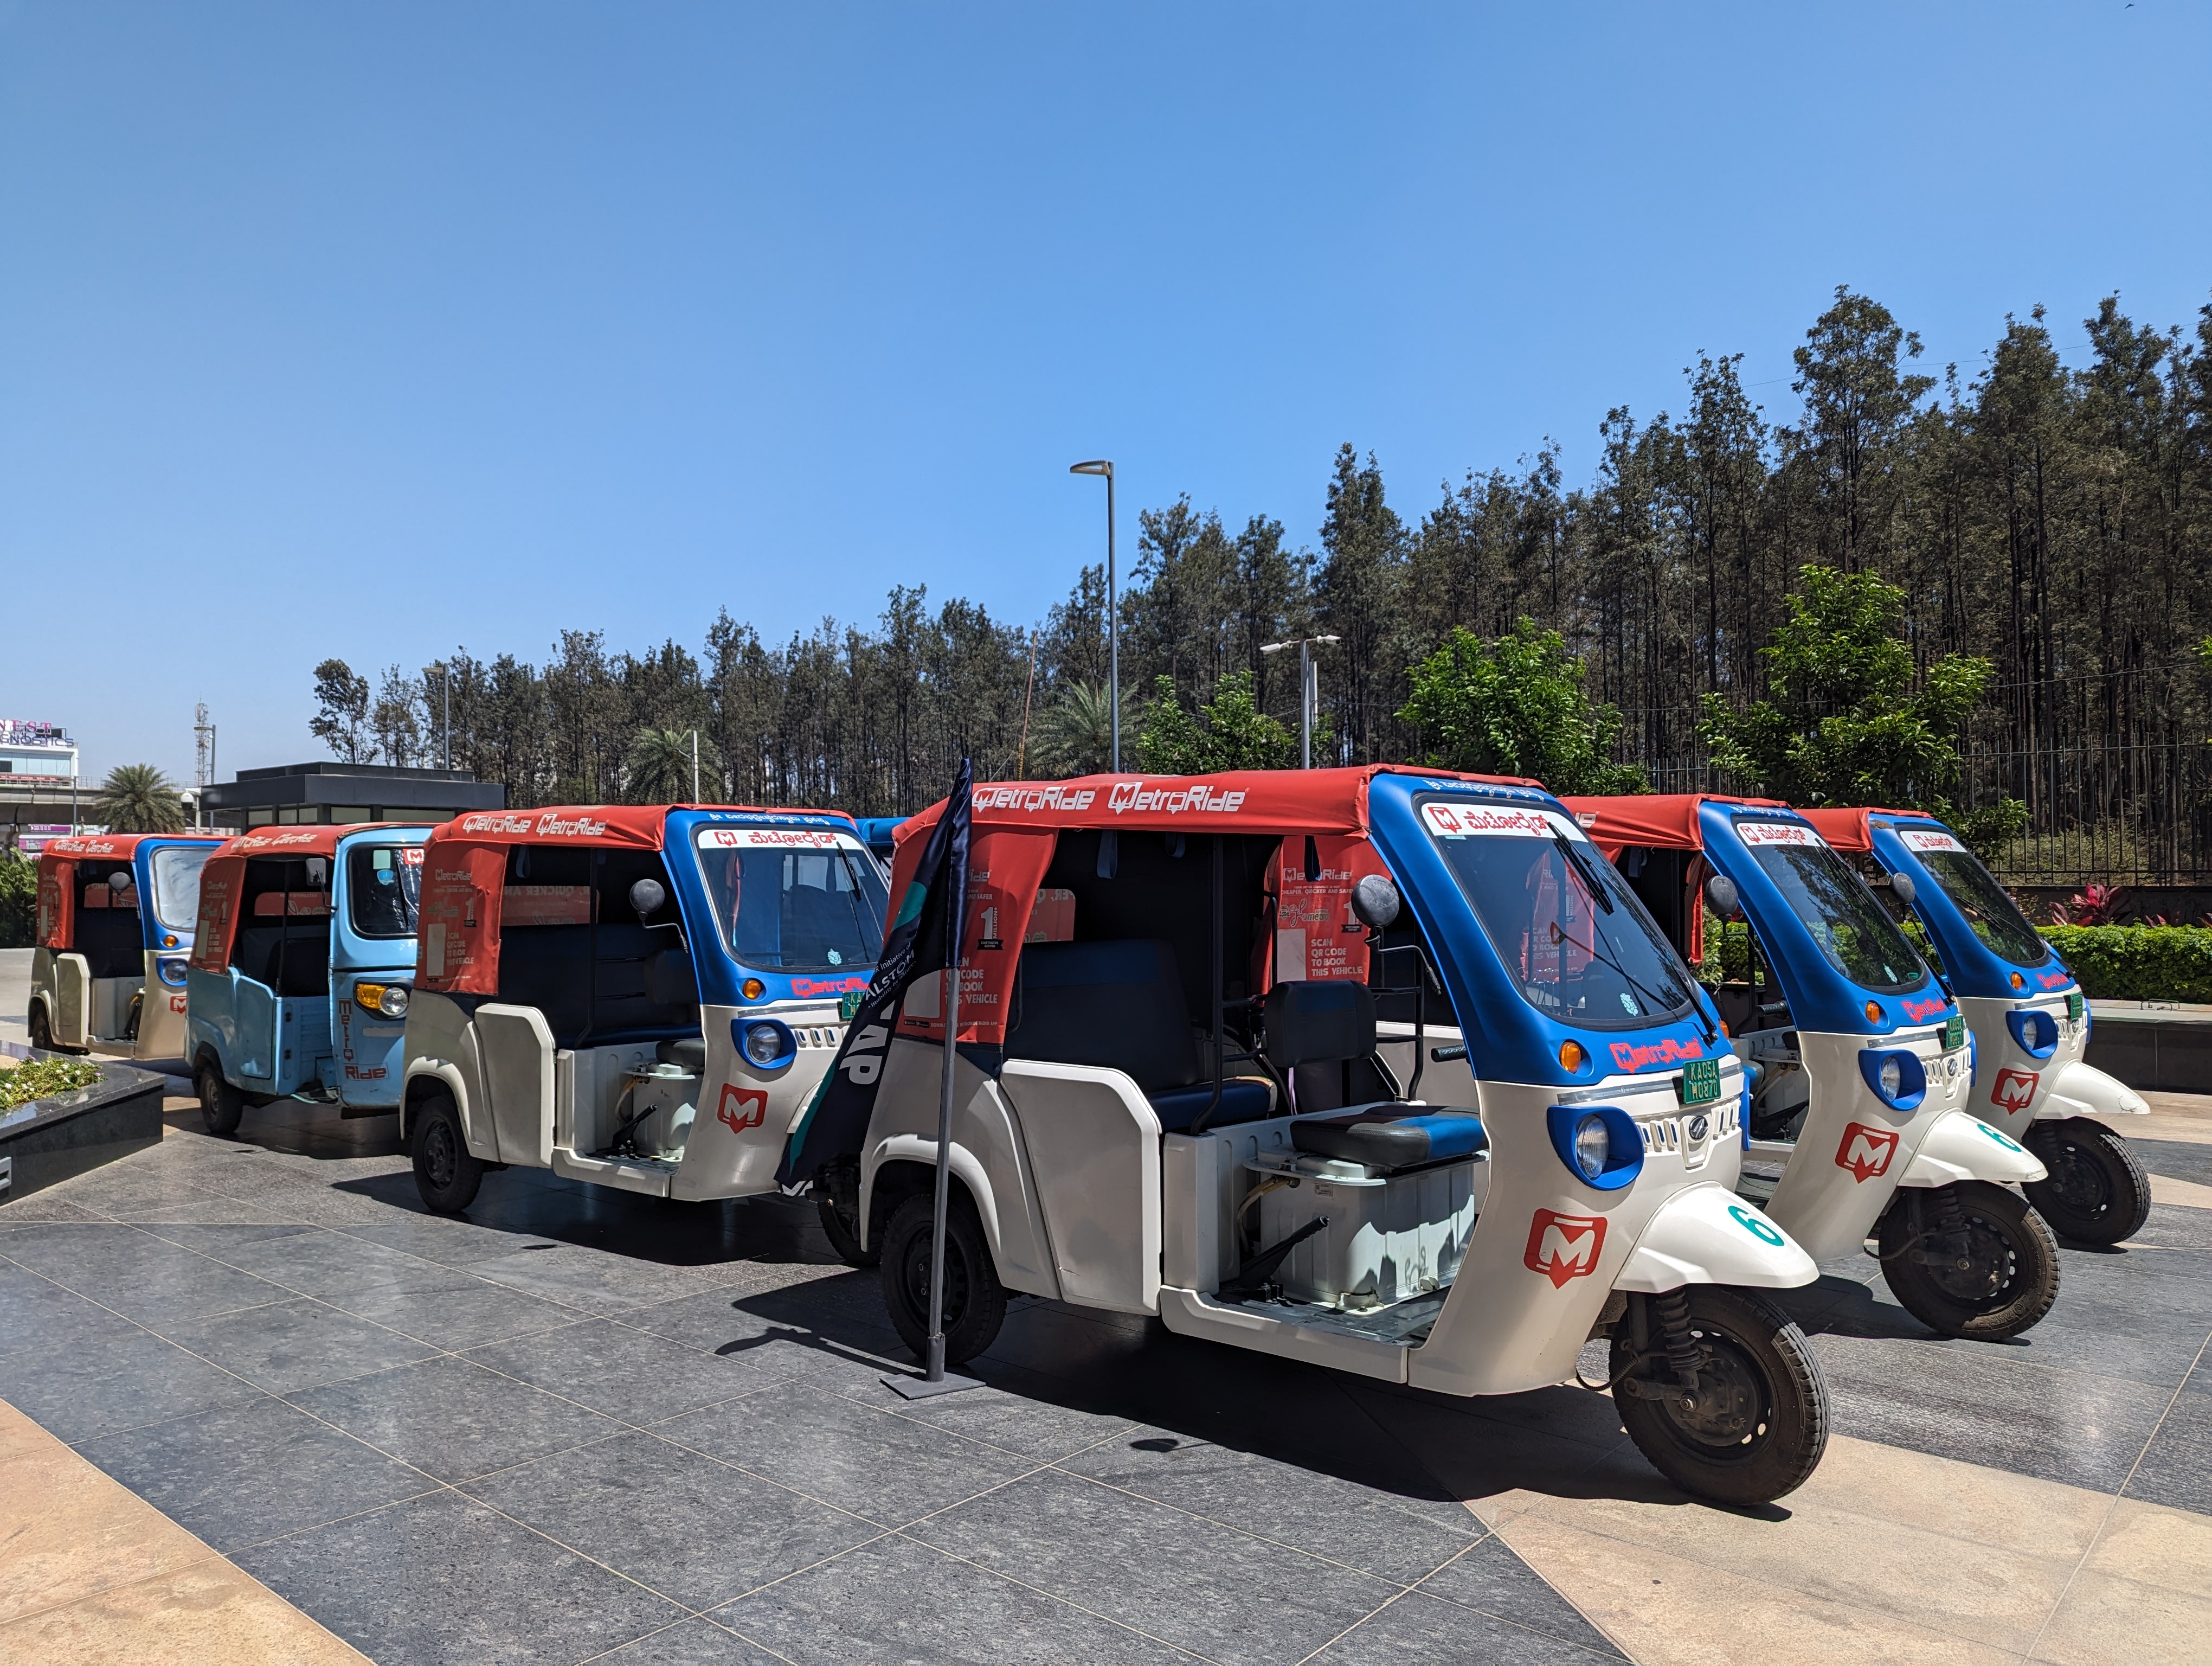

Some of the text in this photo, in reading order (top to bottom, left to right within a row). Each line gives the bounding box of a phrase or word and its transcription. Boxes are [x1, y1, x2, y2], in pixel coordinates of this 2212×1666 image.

[972, 781, 1246, 815] MetroRide MetroRide
[462, 813, 606, 837] MetroRide MetroRide
[1283, 868, 1352, 883] MeRide
[981, 907, 993, 940] 1
[1311, 938, 1333, 947] SCAN
[1311, 947, 1347, 958] QR CODE
[880, 949, 905, 970] Initiative
[1311, 957, 1346, 967] TO BOOK
[960, 970, 984, 979] CODE
[1311, 966, 1364, 977] THIS VEHICLE
[959, 982, 983, 991] BOOK
[966, 994, 998, 1004] VEHICLE
[345, 1066, 387, 1079] Ride
[1690, 1061, 1717, 1081] KA05A
[1728, 1206, 1785, 1246] 6
